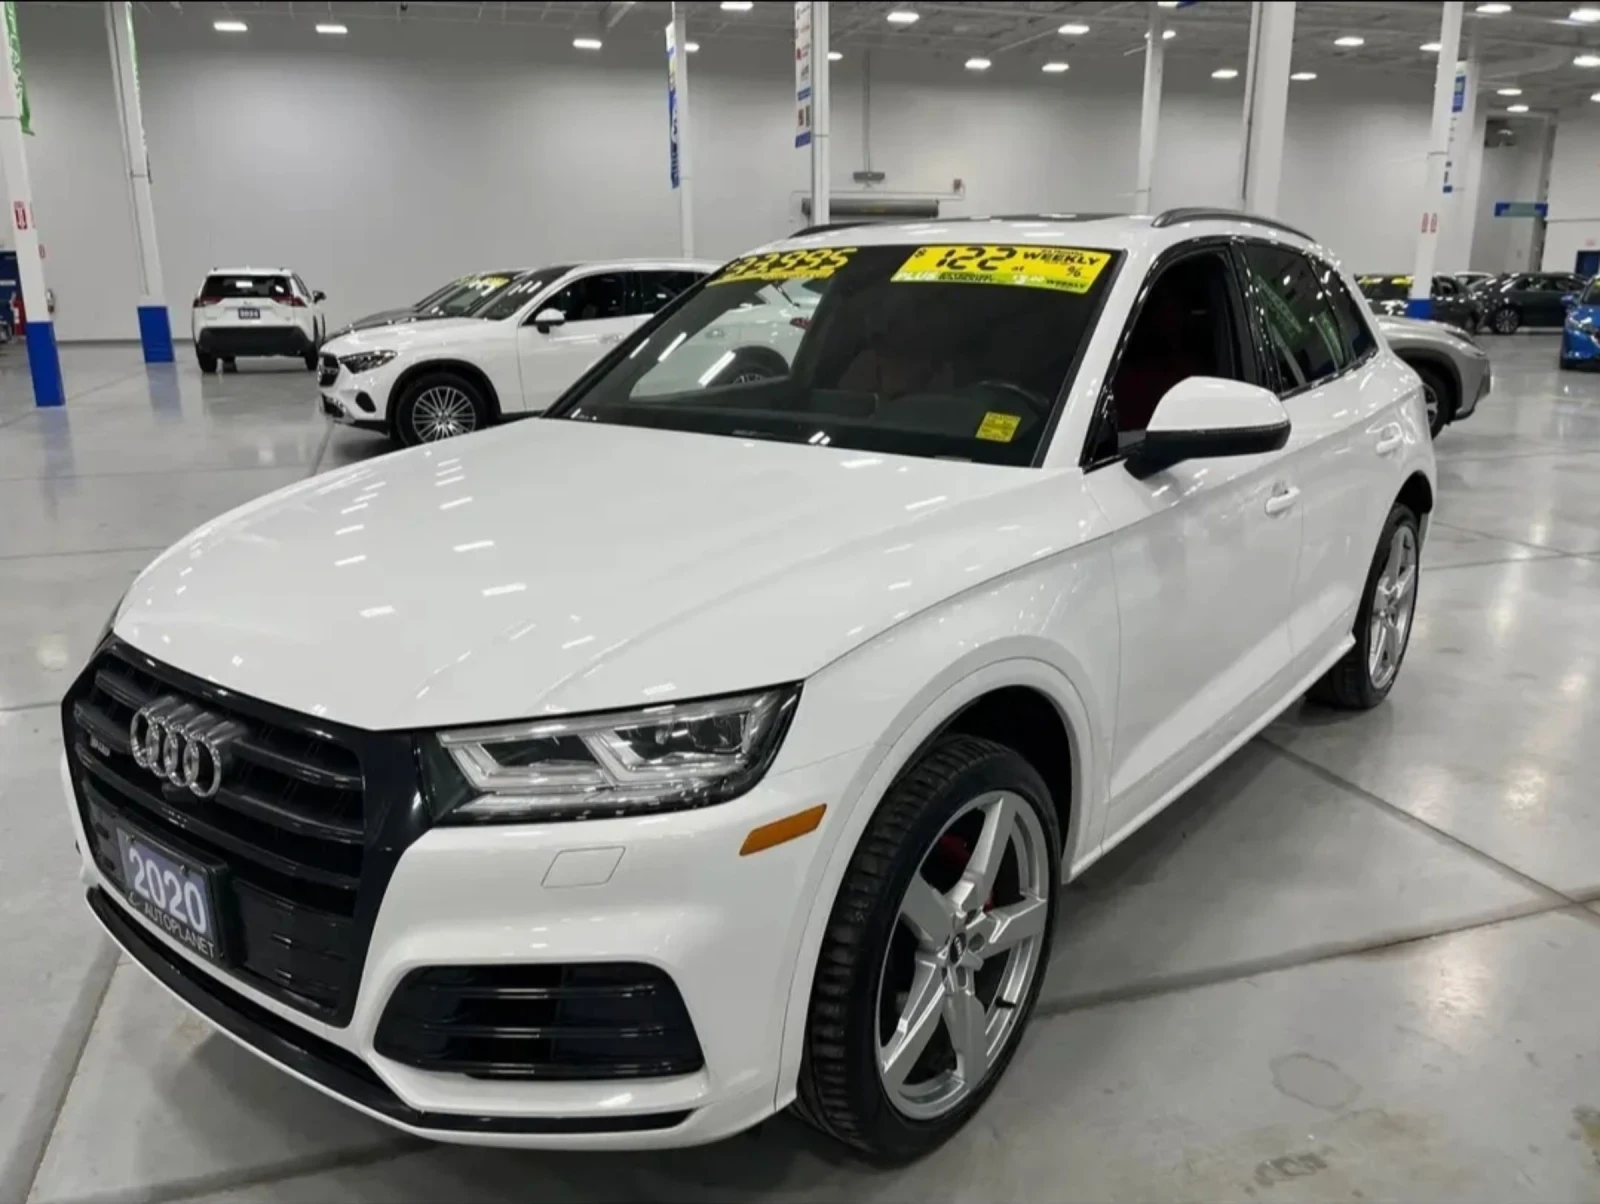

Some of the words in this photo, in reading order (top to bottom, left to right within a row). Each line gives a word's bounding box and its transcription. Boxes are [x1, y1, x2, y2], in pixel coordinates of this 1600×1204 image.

[936, 247, 1018, 271] 122
[1023, 251, 1101, 266] WEEKLY
[129, 847, 207, 935] 2020
[145, 902, 214, 958] AUTOPLANET
